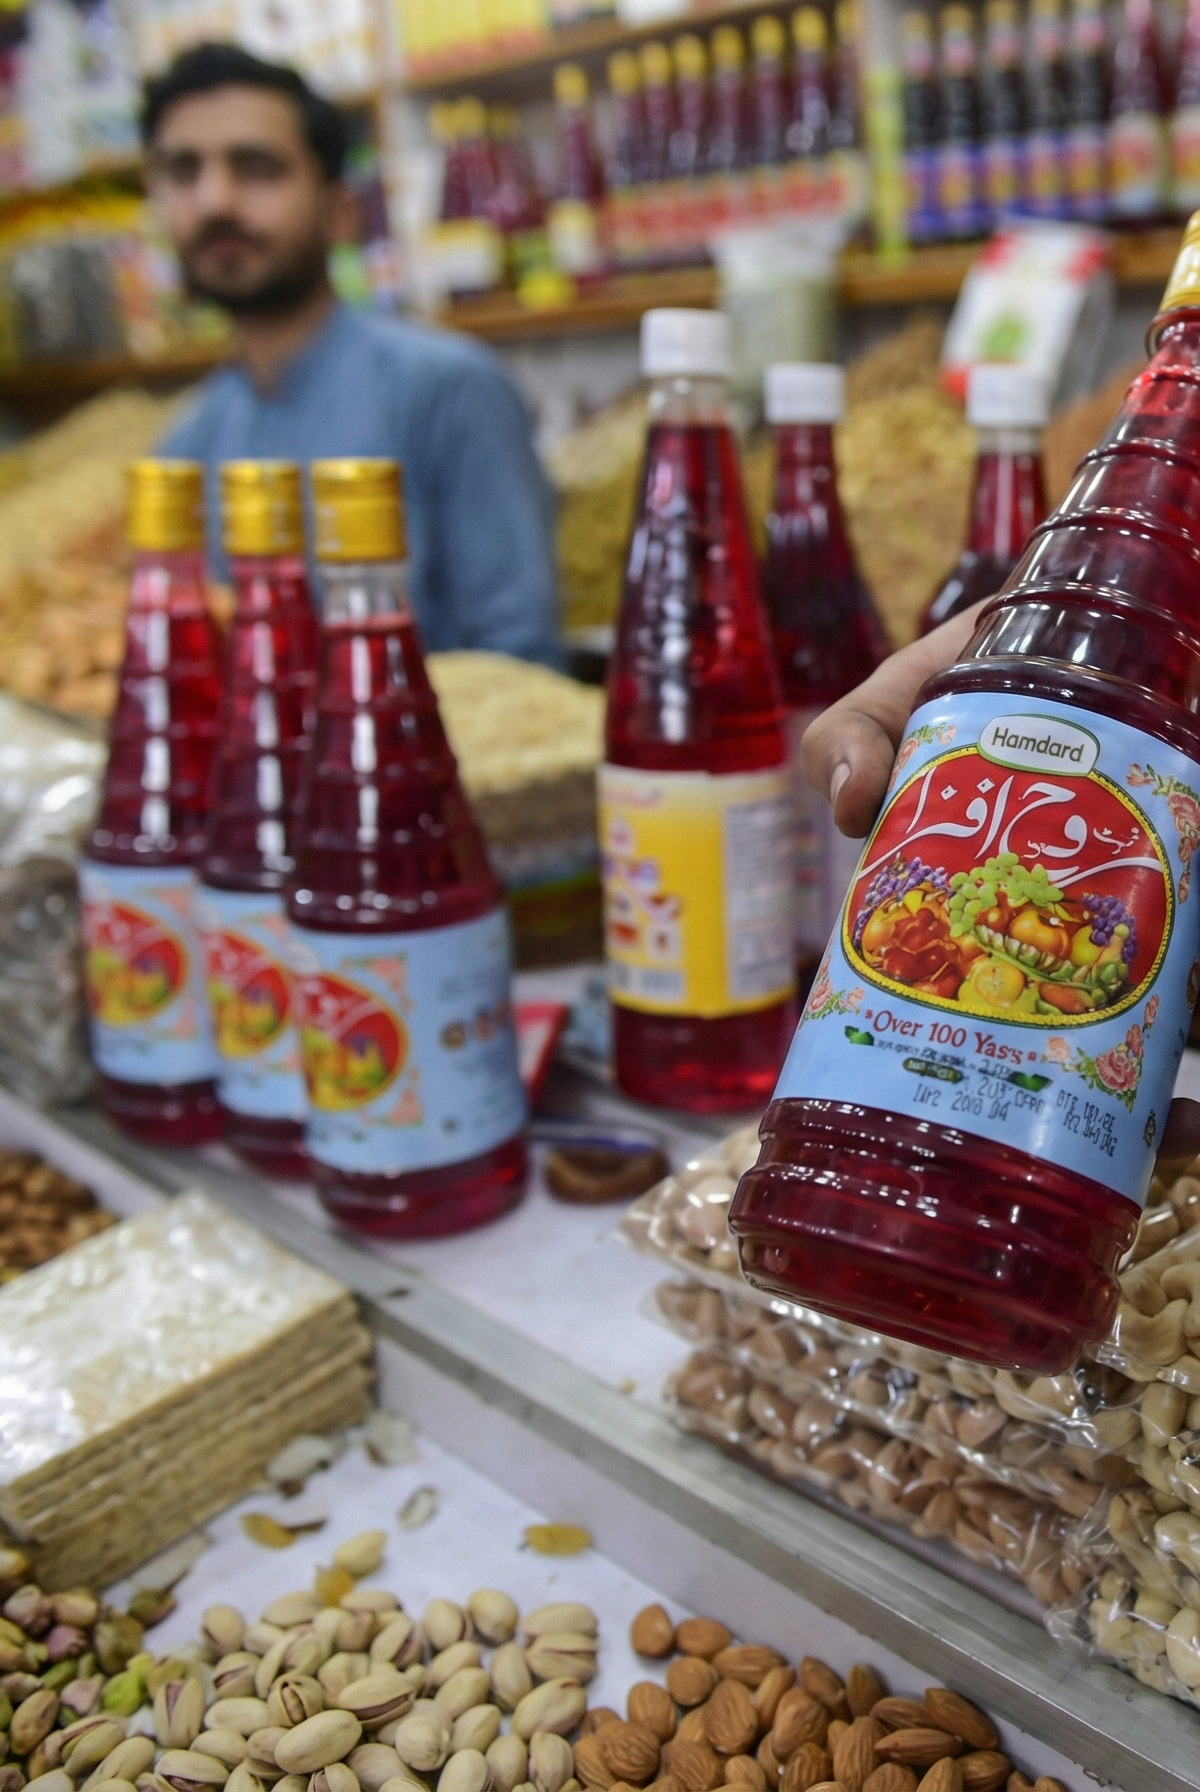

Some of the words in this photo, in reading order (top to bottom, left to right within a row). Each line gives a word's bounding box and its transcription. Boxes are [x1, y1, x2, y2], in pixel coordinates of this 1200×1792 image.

[991, 726, 1085, 764] Hamdard
[872, 1009, 923, 1037] Over
[929, 1021, 968, 1048] 100
